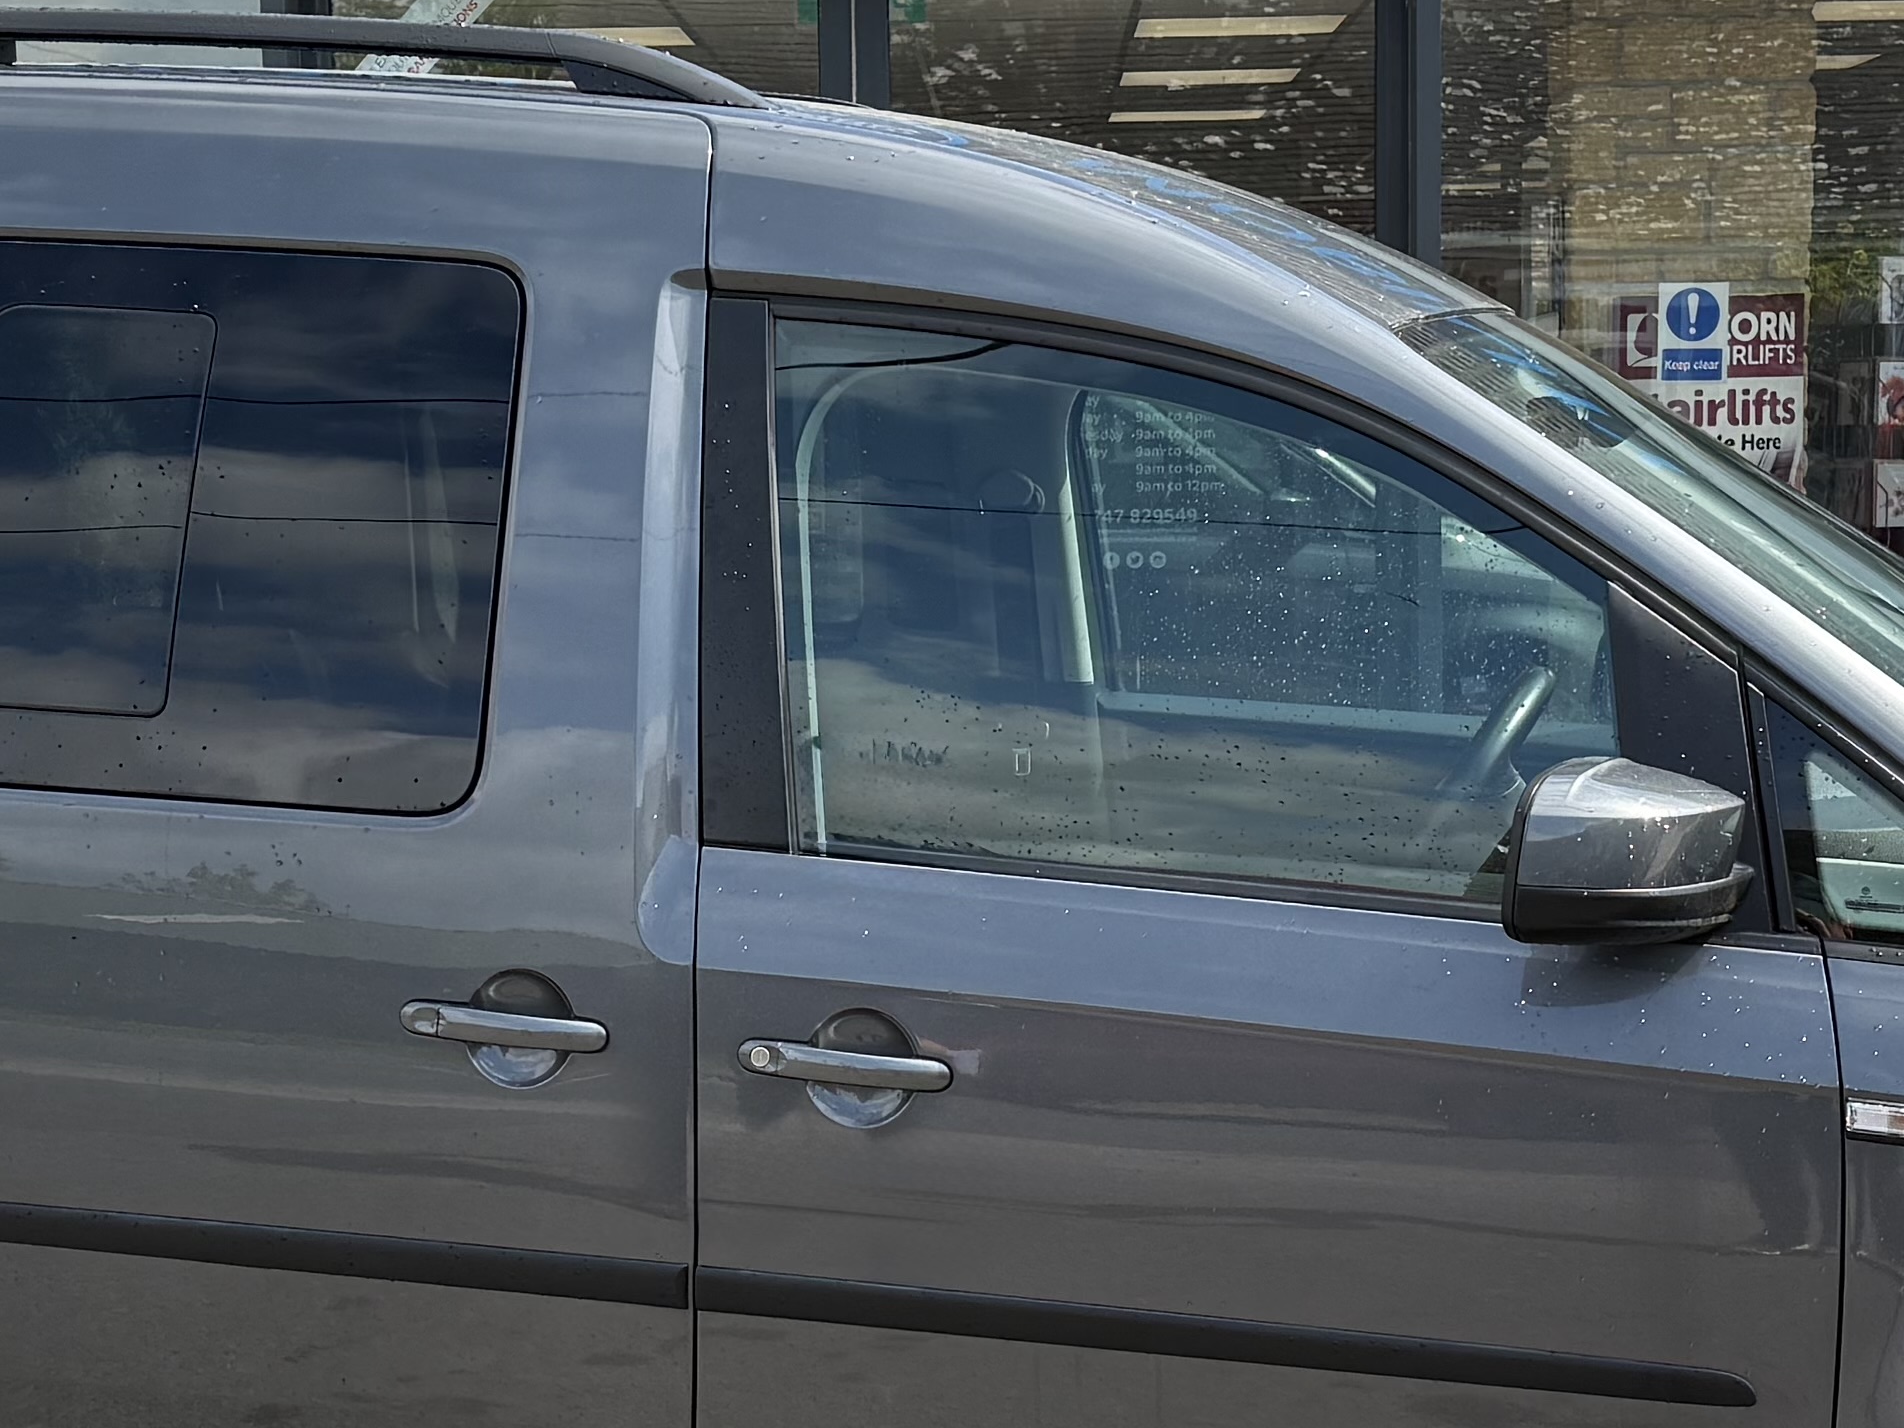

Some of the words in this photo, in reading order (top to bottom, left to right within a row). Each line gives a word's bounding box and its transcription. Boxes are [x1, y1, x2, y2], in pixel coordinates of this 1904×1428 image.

[1728, 311, 1795, 342] ORN
[1663, 359, 1691, 371] Keep
[1693, 359, 1720, 371] clear
[1666, 388, 1796, 427] airlifts
[1741, 434, 1782, 451] Here
[1135, 463, 1165, 475] 9am
[1135, 480, 1165, 492] 9am
[1129, 507, 1198, 524] 829549
